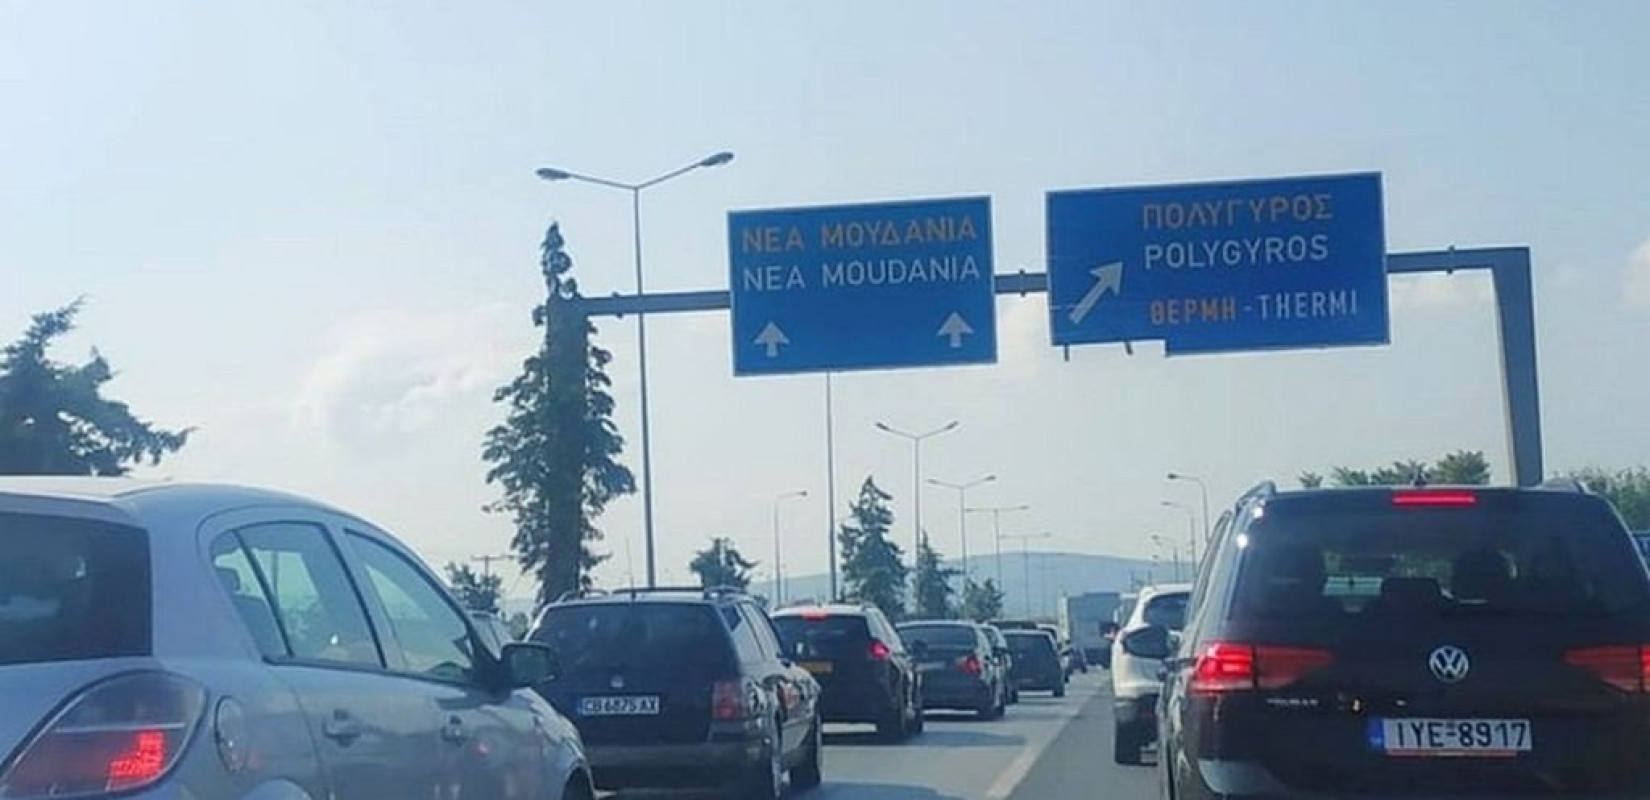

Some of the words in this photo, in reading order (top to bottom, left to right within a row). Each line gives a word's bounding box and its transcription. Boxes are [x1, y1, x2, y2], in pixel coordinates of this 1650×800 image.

[1142, 193, 1334, 230] ΠΟΛΥΓΥΡΟΣ
[742, 225, 804, 253] ΝΕΑ
[821, 215, 977, 249] ΜΟΥΔΑΝΙΑ
[1144, 234, 1329, 270] POLYGYROS
[743, 265, 805, 291] NEA
[822, 254, 980, 288] MOUDANIA
